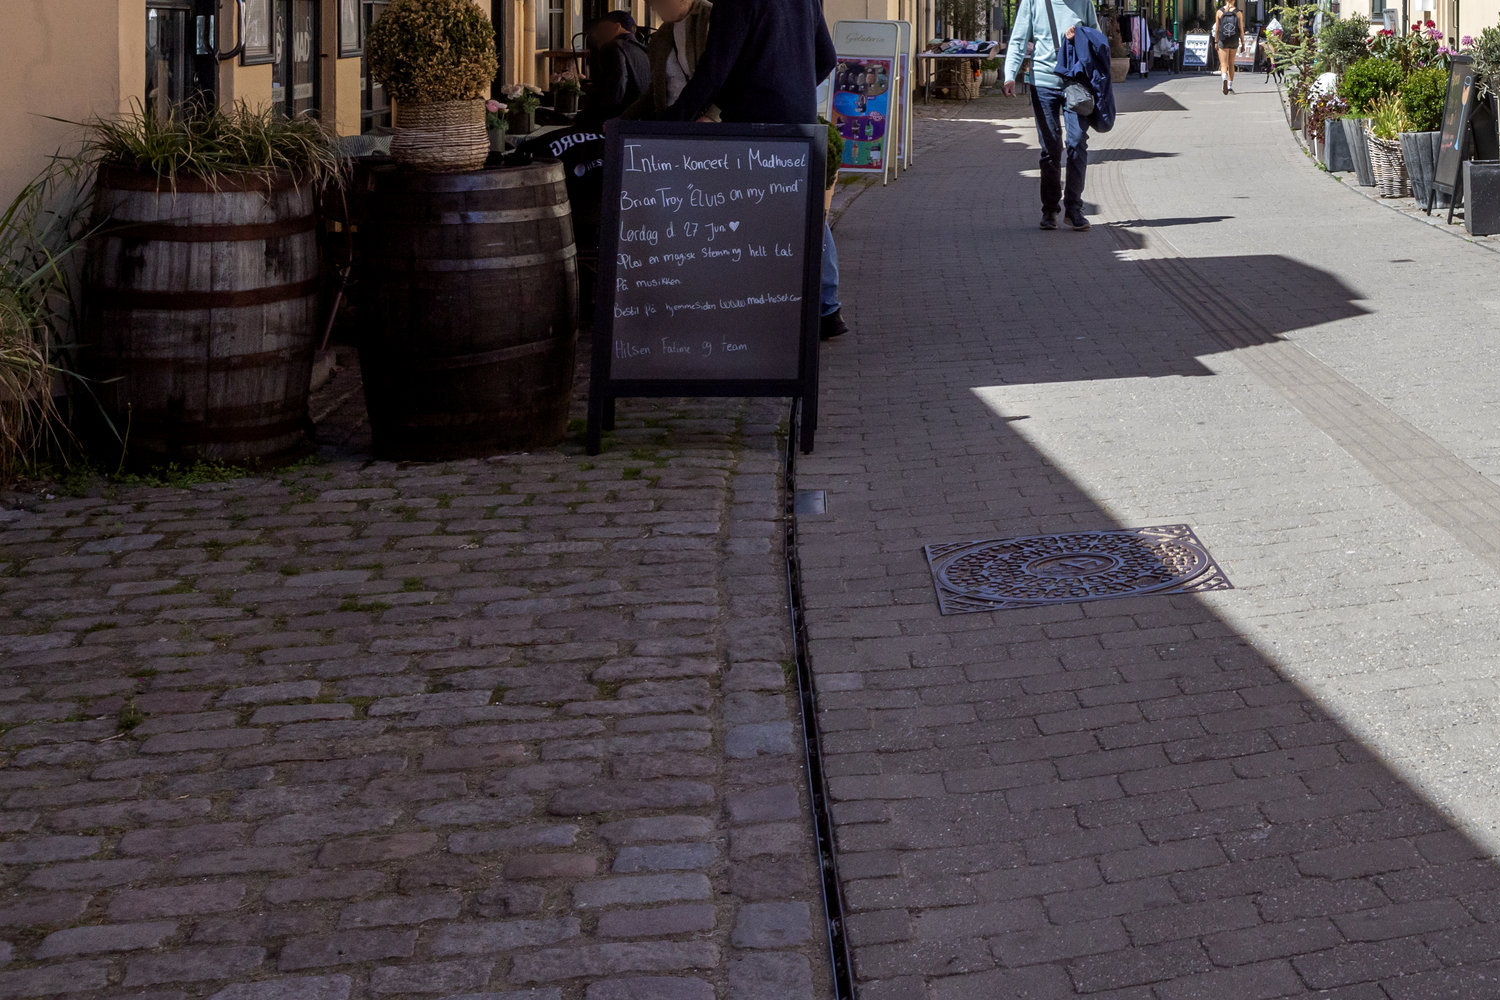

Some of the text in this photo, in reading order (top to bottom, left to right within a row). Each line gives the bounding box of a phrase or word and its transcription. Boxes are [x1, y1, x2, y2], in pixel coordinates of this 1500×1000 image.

[748, 147, 807, 171] Madhuset
[619, 190, 657, 211] Brian
[656, 186, 683, 213] Troy
[746, 187, 766, 205] my
[619, 220, 658, 246] Lørdag
[683, 221, 699, 237] 27
[747, 243, 768, 257] helt
[613, 303, 640, 319] Bestil
